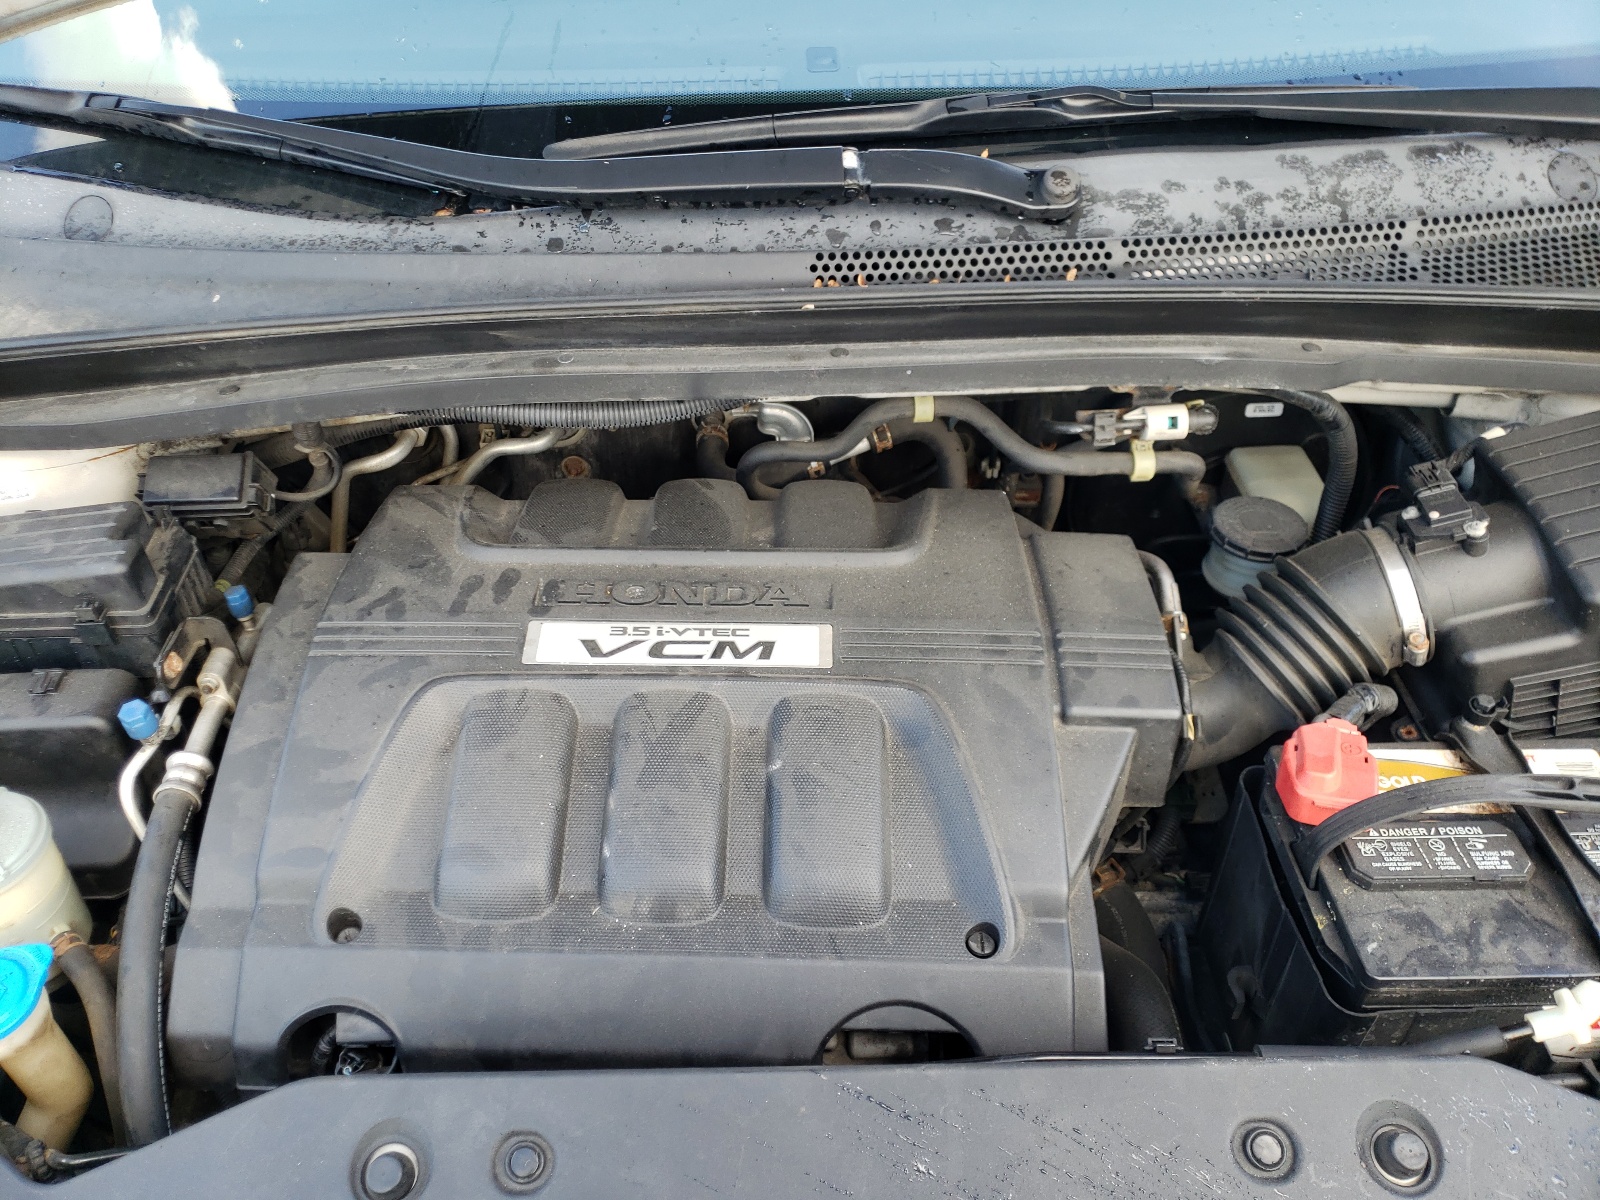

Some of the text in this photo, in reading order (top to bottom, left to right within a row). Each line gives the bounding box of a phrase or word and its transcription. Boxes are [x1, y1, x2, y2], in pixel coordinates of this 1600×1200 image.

[554, 580, 810, 607] HONDA
[609, 626, 649, 637] 3.5
[578, 639, 777, 661] VCM
[1380, 827, 1428, 837] DANGER
[1438, 826, 1483, 836] POISON
